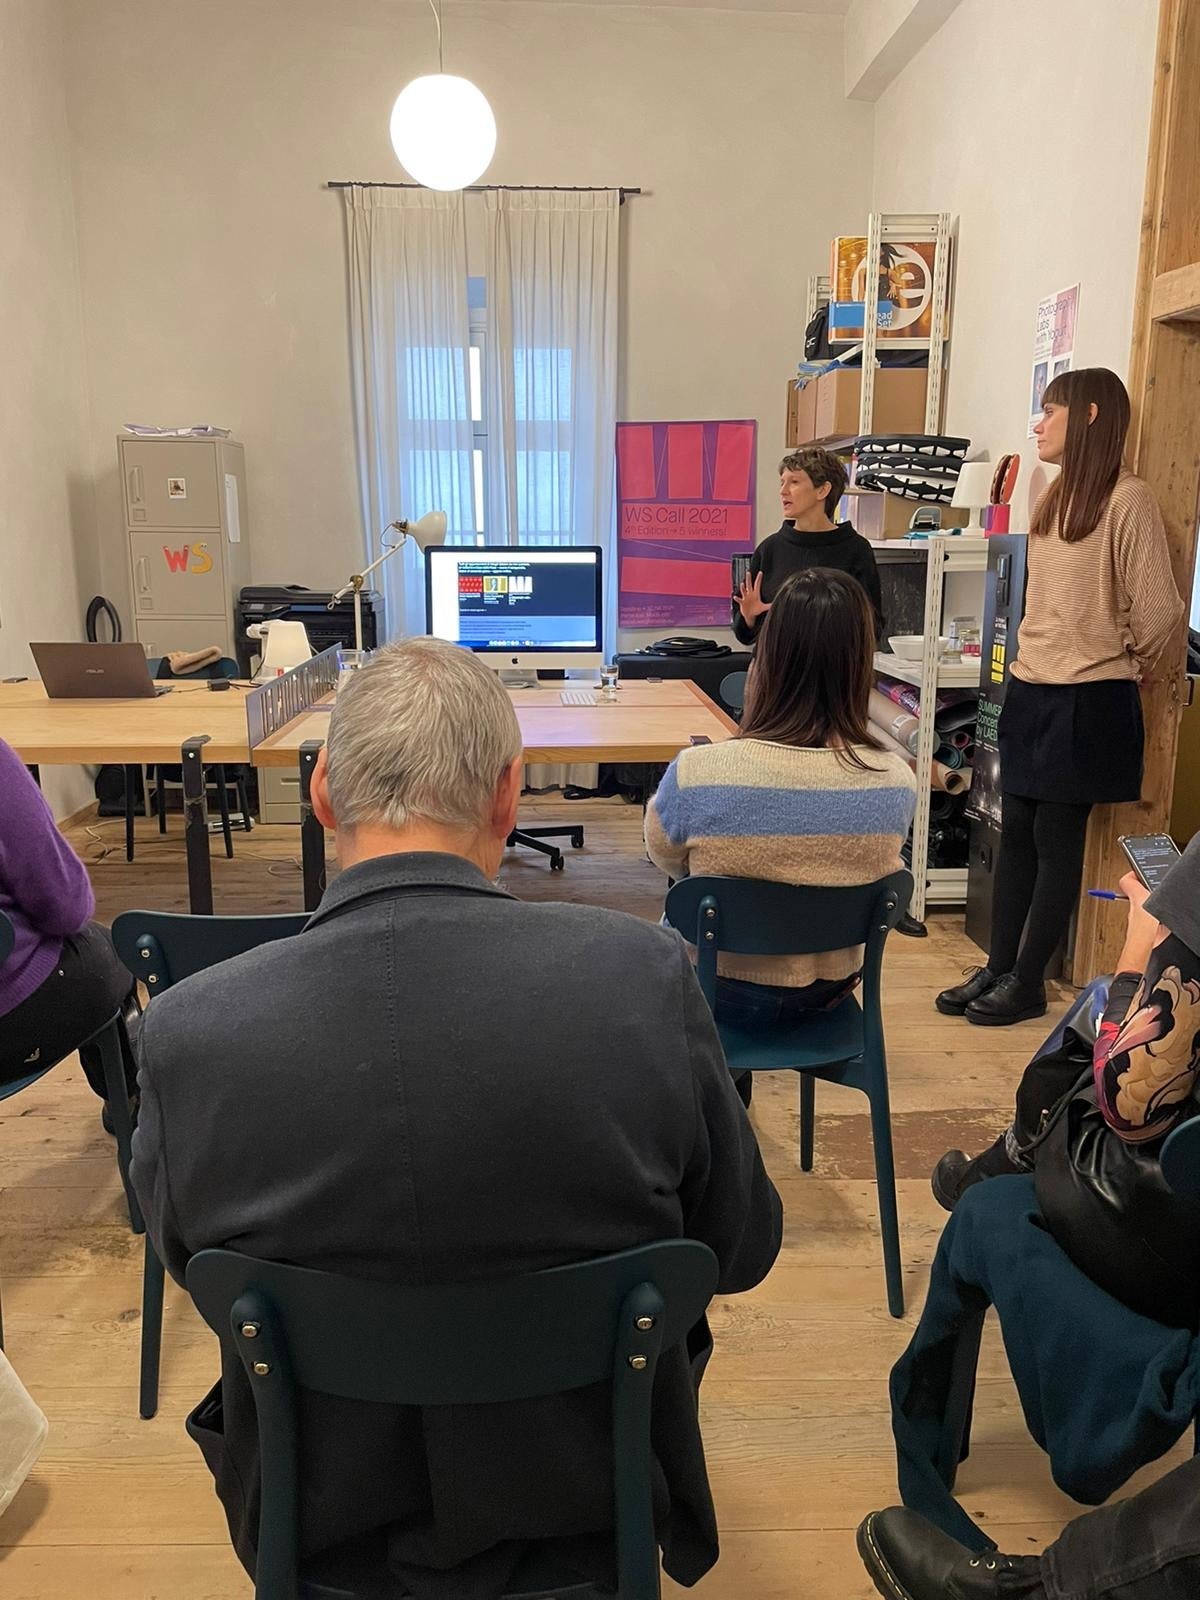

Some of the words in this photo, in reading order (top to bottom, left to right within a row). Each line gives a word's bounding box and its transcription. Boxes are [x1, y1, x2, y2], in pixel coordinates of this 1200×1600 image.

[625, 507, 652, 522] WS
[656, 507, 684, 523] Call
[688, 508, 728, 524] 2021
[638, 526, 668, 535] Edition
[162, 541, 213, 574] WS
[978, 699, 1002, 716] SUMMER
